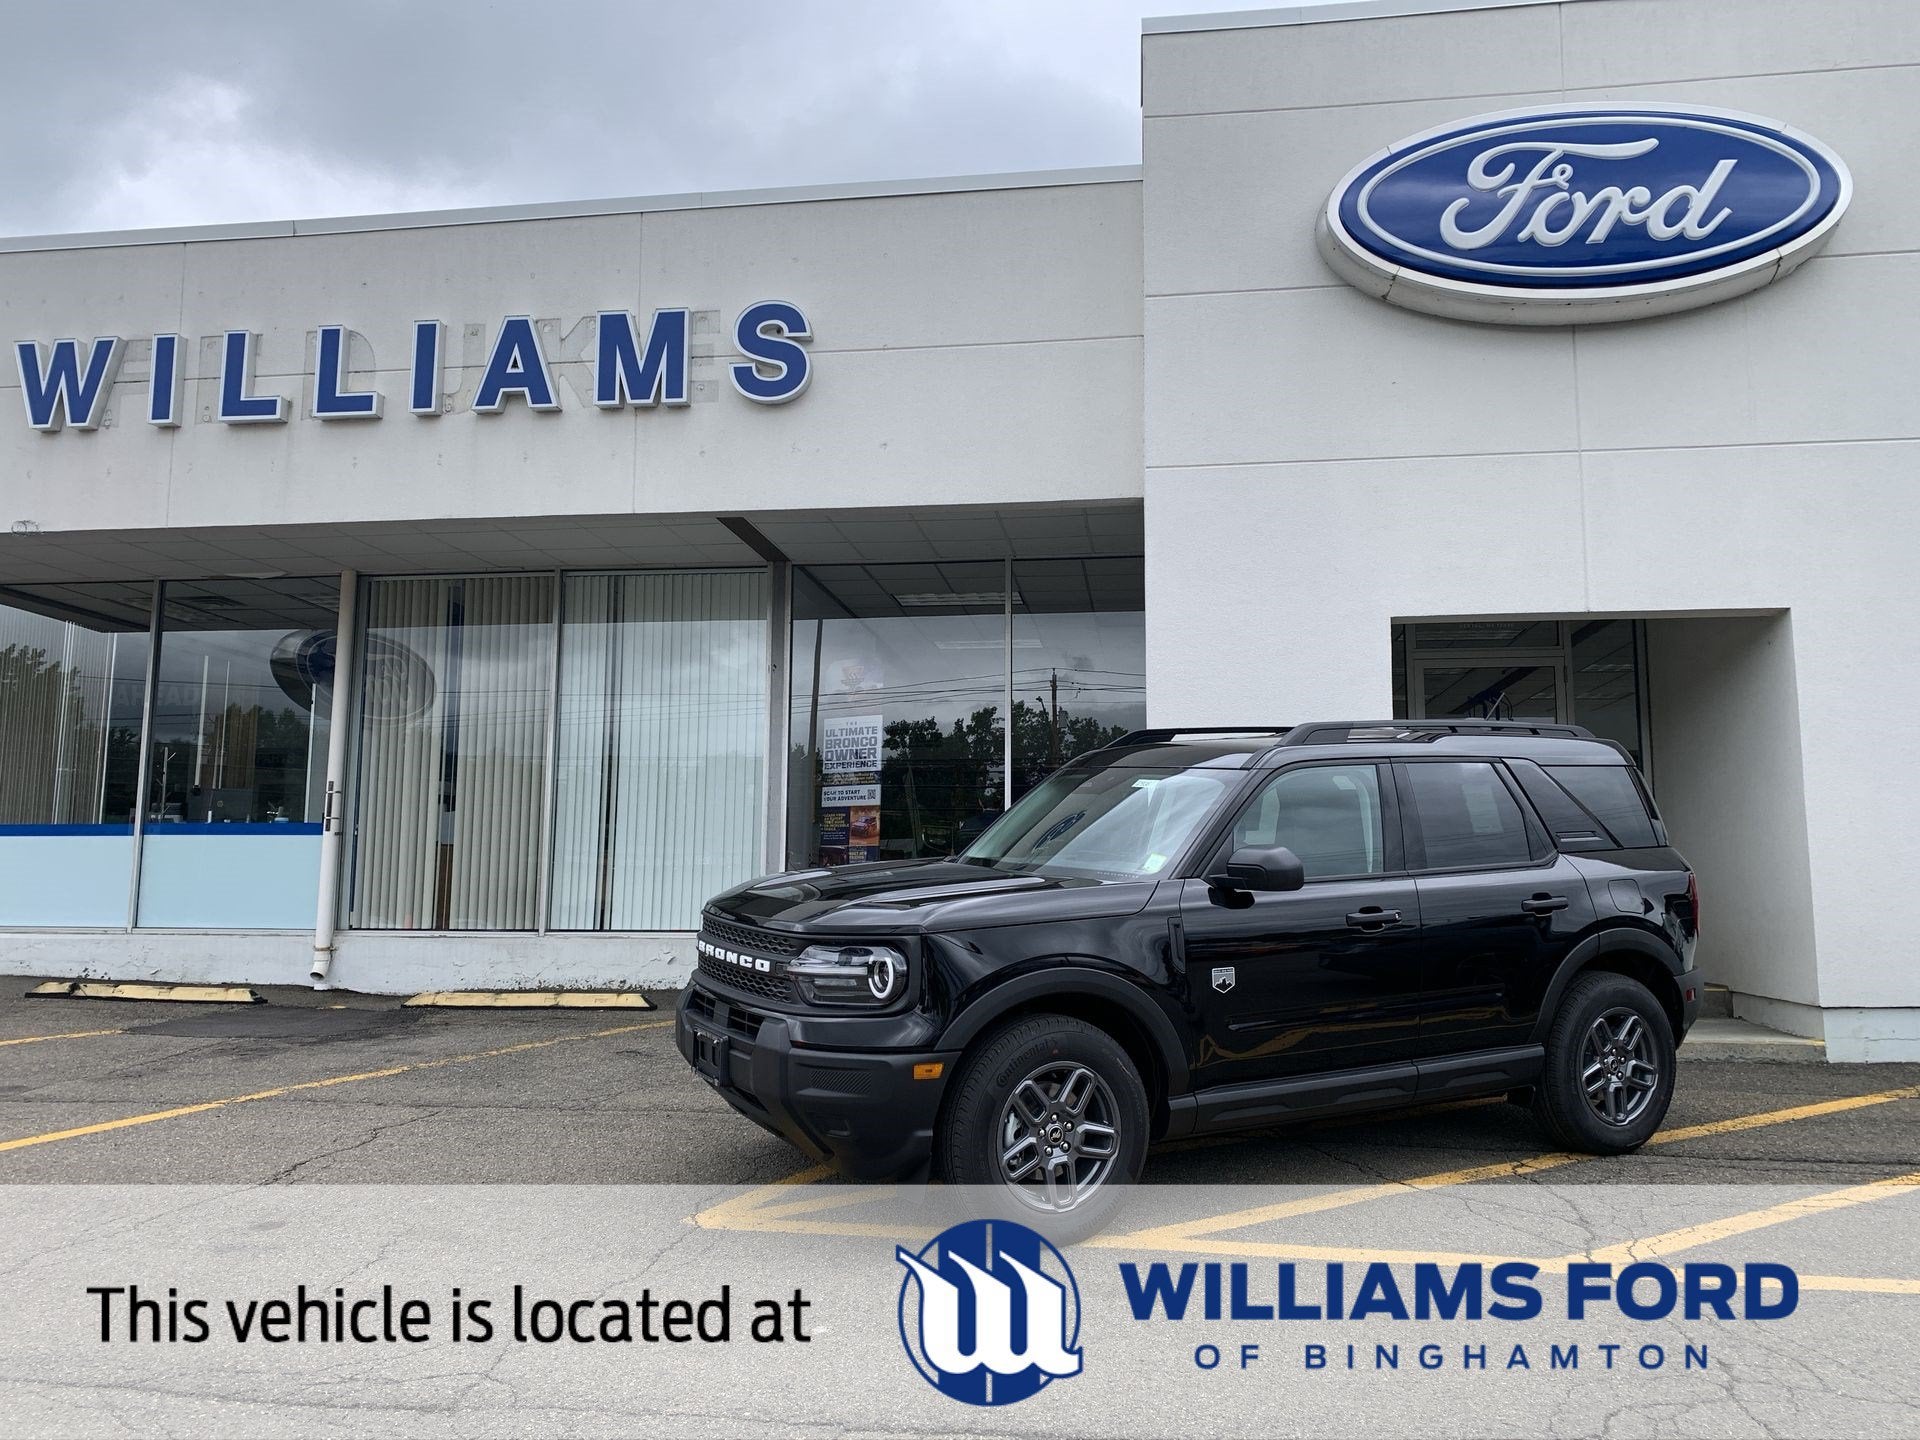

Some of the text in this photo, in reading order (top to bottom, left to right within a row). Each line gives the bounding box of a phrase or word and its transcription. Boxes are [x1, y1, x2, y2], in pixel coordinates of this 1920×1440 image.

[1439, 137, 1738, 250] Ford
[14, 300, 814, 433] WILLIAMS
[825, 726, 878, 738] ULTIMATE
[825, 736, 878, 749] BRONCO
[824, 747, 877, 761] OWNER
[824, 760, 877, 770] EXPERIENCE
[697, 940, 771, 973] BRONCO
